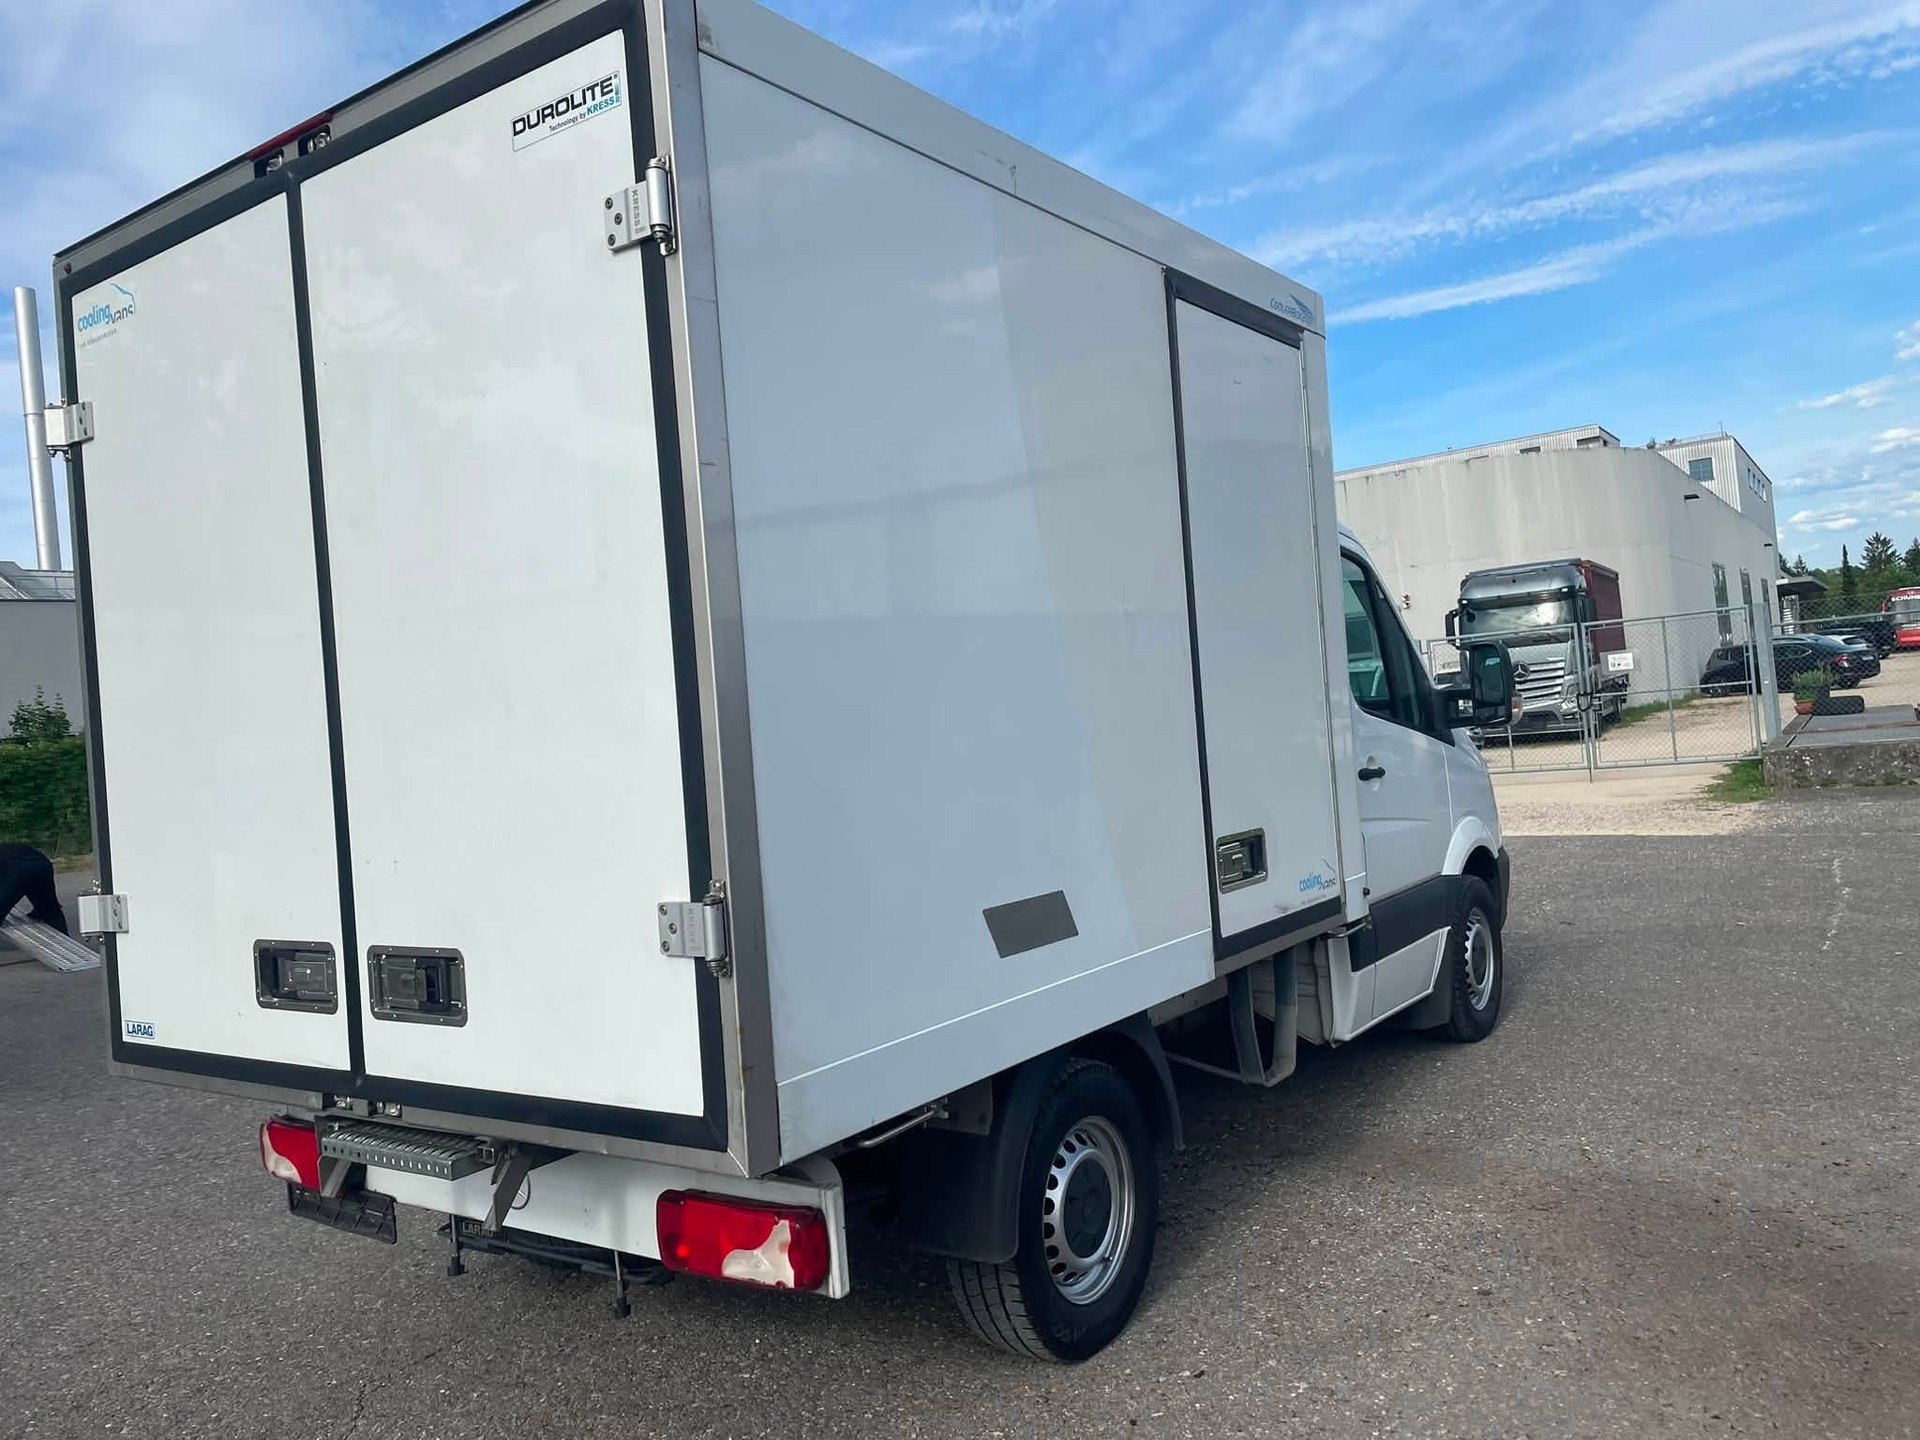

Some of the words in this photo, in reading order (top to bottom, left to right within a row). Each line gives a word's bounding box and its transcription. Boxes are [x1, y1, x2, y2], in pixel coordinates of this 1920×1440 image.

[512, 75, 614, 137] DUROLITE
[549, 114, 579, 132] Technology
[586, 96, 615, 116] KRESS
[126, 1022, 154, 1037] LARAG
